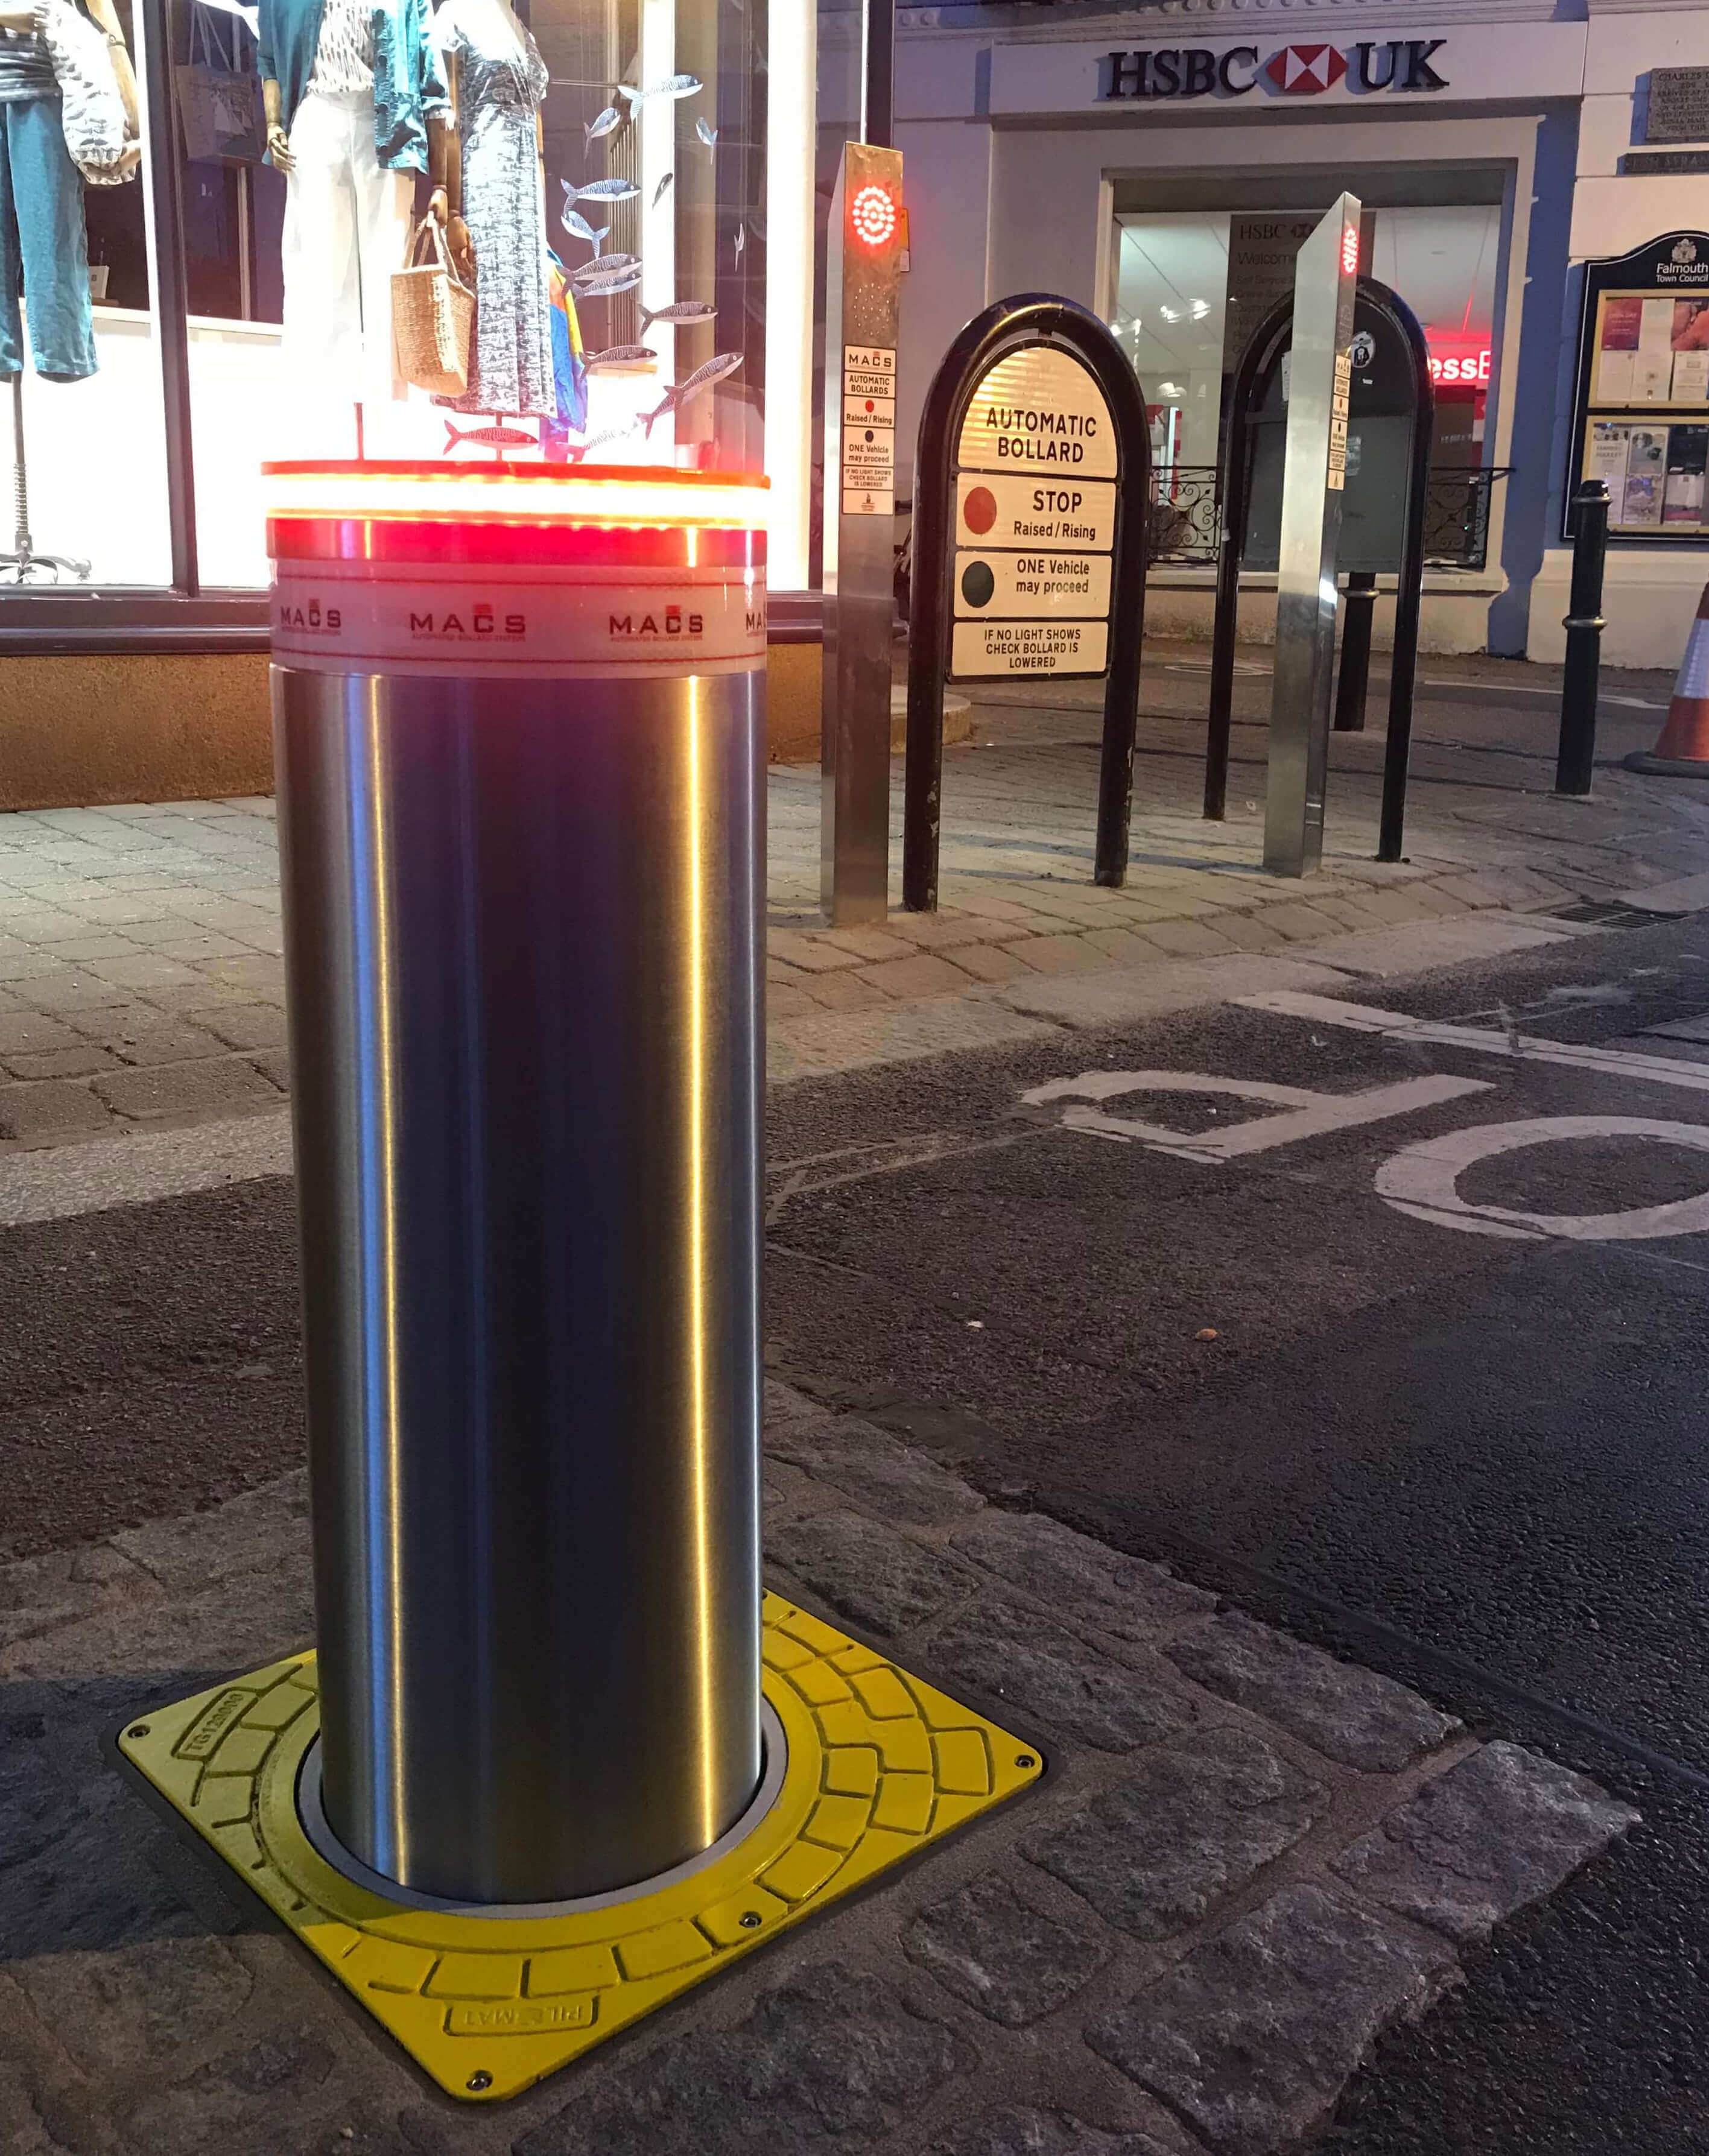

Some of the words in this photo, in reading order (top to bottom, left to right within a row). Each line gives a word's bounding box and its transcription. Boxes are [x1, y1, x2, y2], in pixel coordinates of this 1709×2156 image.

[1107, 46, 1258, 96] HSBC
[1355, 40, 1449, 89] UK
[1240, 223, 1287, 239] HSBC
[1657, 262, 1708, 274] Falmouth
[1656, 274, 1677, 283] Town
[1679, 274, 1708, 282] Council
[849, 353, 892, 367] MACS
[849, 375, 890, 386] AUTOMATIC
[851, 385, 889, 395] BOLLARDS
[846, 413, 868, 422] Raised
[873, 415, 892, 425] Rising
[986, 407, 1097, 437] AUTOMATIC
[849, 444, 864, 452] ONE
[866, 444, 889, 454] Vehicle
[998, 437, 1084, 463] BOLLARD
[1033, 490, 1083, 513] STOP
[1014, 521, 1053, 537] Raised
[1062, 523, 1096, 541] Rising
[1017, 558, 1045, 574] ONE
[1050, 559, 1090, 575] Vehicle
[1016, 581, 1040, 595] may
[1044, 580, 1089, 593] proceed
[280, 605, 341, 628] MACS
[410, 612, 526, 634] MACS
[746, 612, 766, 631] MA
[609, 615, 703, 634] MACS
[984, 629, 994, 640] IF
[997, 629, 1012, 640] NO
[1015, 629, 1043, 640] LIGHT
[1046, 628, 1081, 640] SHOWS
[986, 643, 1019, 654] CHECK
[1023, 642, 1066, 654] BOLLARD
[1069, 642, 1078, 653] IS
[1009, 657, 1056, 669] LOWERED
